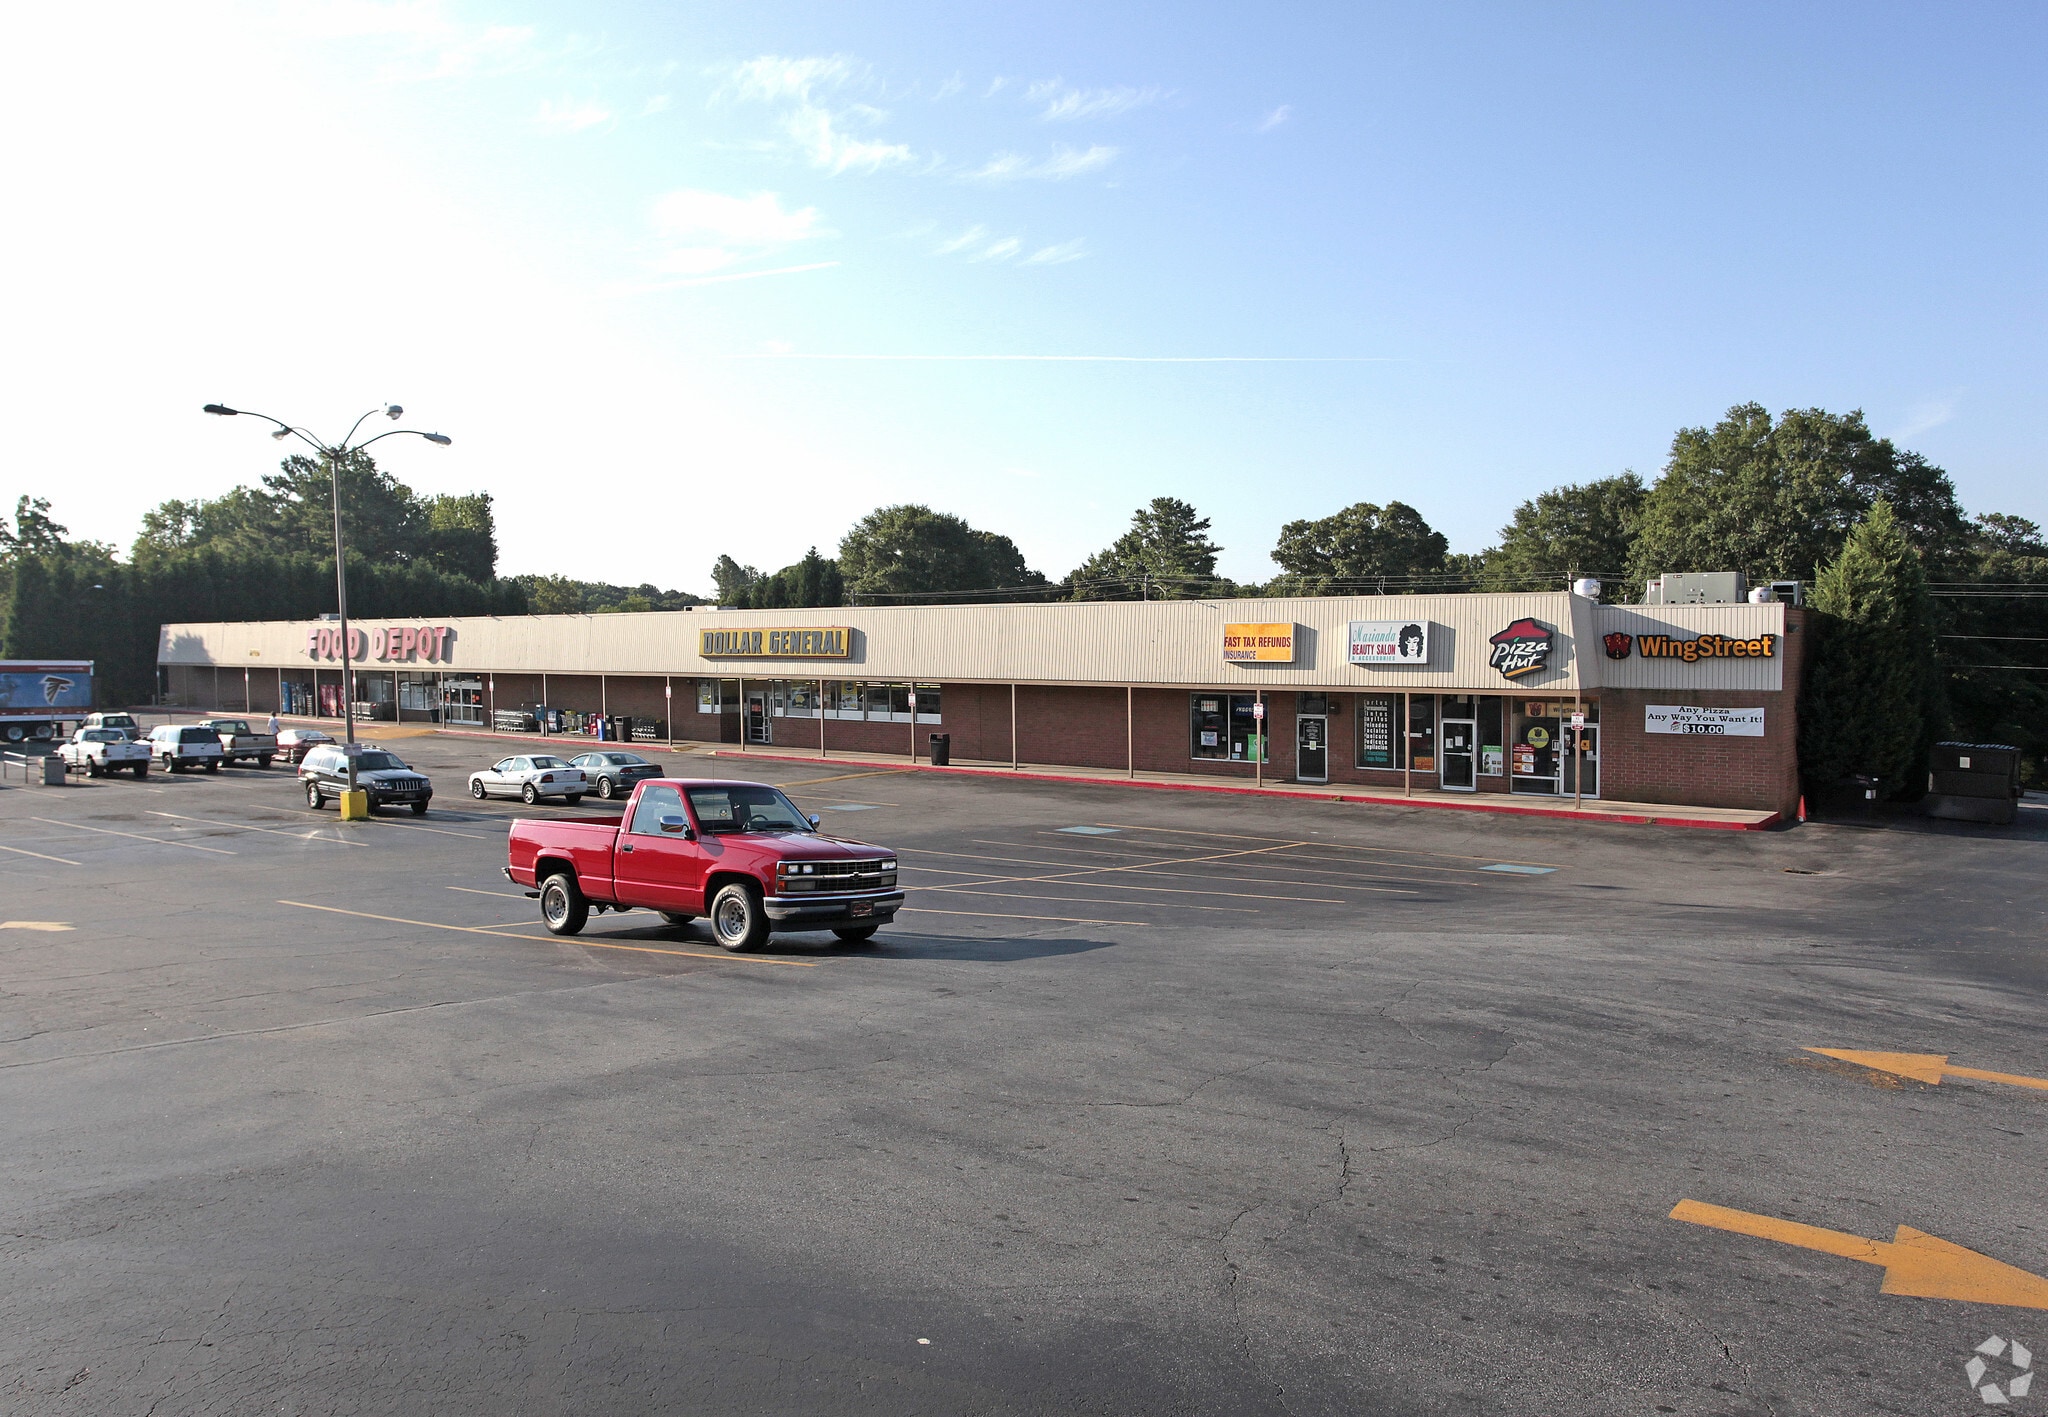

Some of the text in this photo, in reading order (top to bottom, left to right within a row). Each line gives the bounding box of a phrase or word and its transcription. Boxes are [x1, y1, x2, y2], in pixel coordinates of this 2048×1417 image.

[306, 626, 447, 660] FOOD DEPOT
[703, 630, 845, 655] DOLLAR GENERAL
[1224, 636, 1291, 648] FAST TAX REFUNDS
[1352, 644, 1396, 655] BEAUTY SALON
[1491, 637, 1549, 665] Pizza
[1638, 635, 1772, 662] WingStreet
[1223, 650, 1256, 660] INSURANCE
[1500, 653, 1542, 672] Hut
[1678, 706, 1697, 714] Any
[1647, 713, 1667, 721] Any
[1671, 714, 1692, 722] Way
[1682, 724, 1724, 734] $10.00
